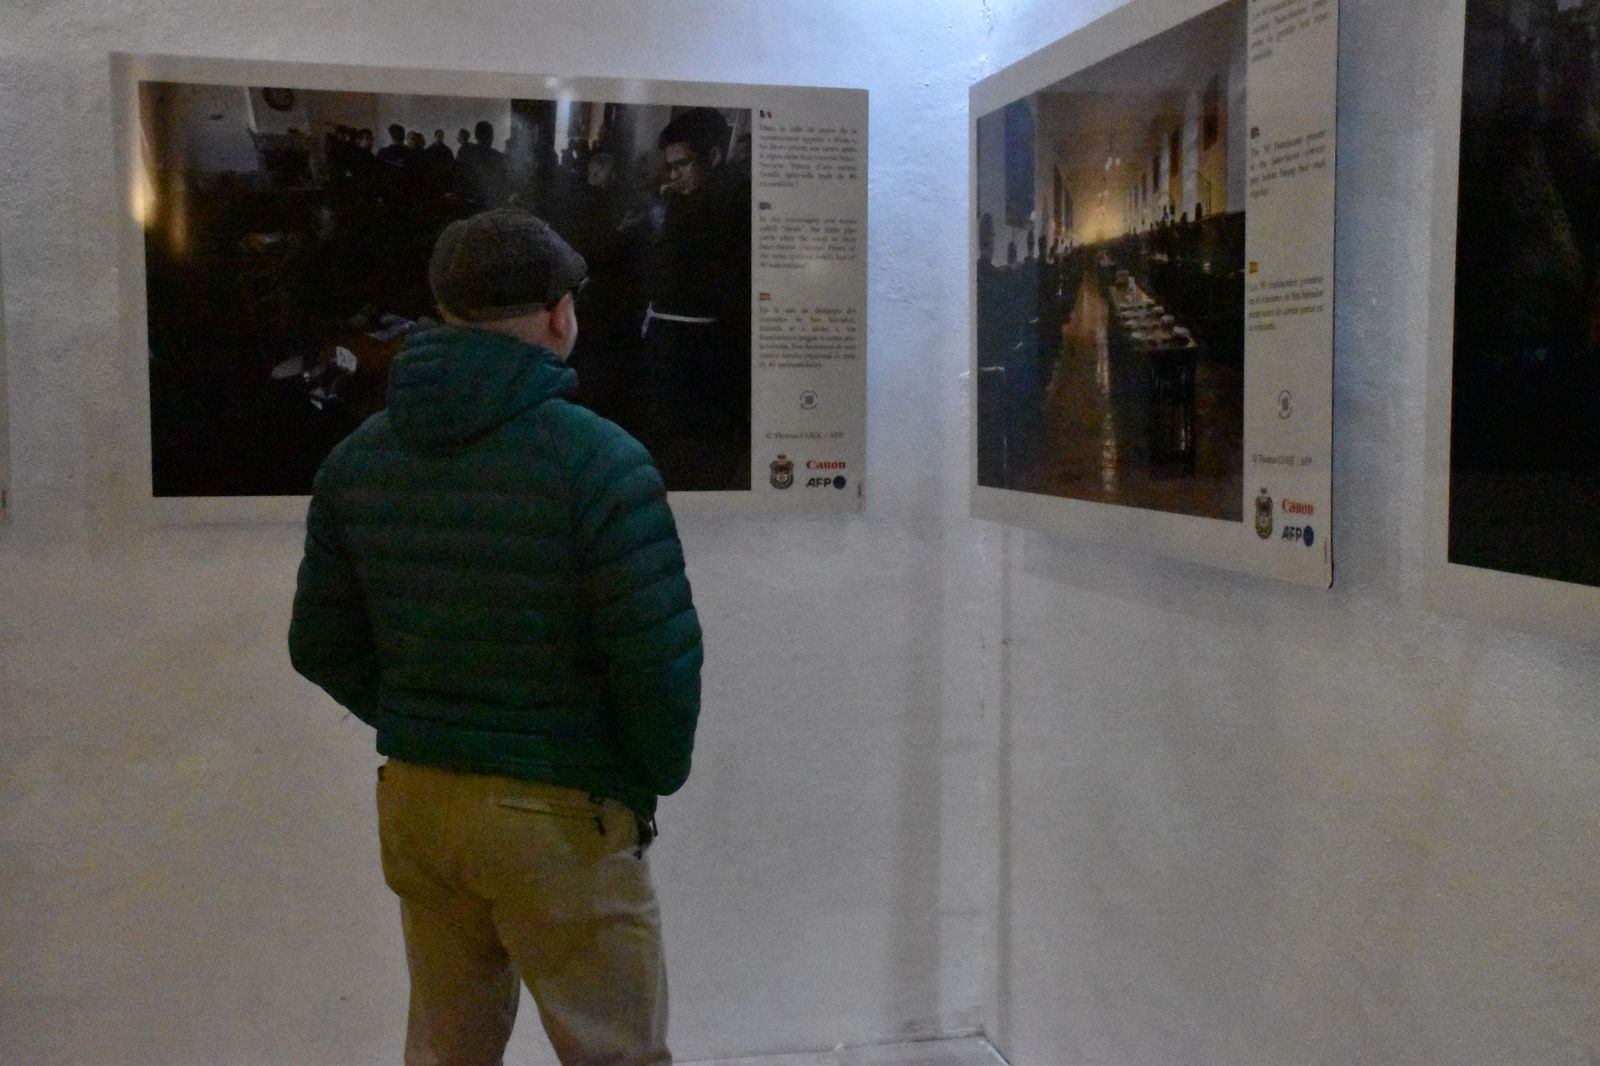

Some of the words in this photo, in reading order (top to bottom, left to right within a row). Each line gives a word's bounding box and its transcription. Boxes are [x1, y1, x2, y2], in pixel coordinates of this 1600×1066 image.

[806, 460, 846, 470] Canon
[806, 477, 832, 487] AFP
[1281, 499, 1314, 515] Canon
[1281, 525, 1302, 541] AFP
